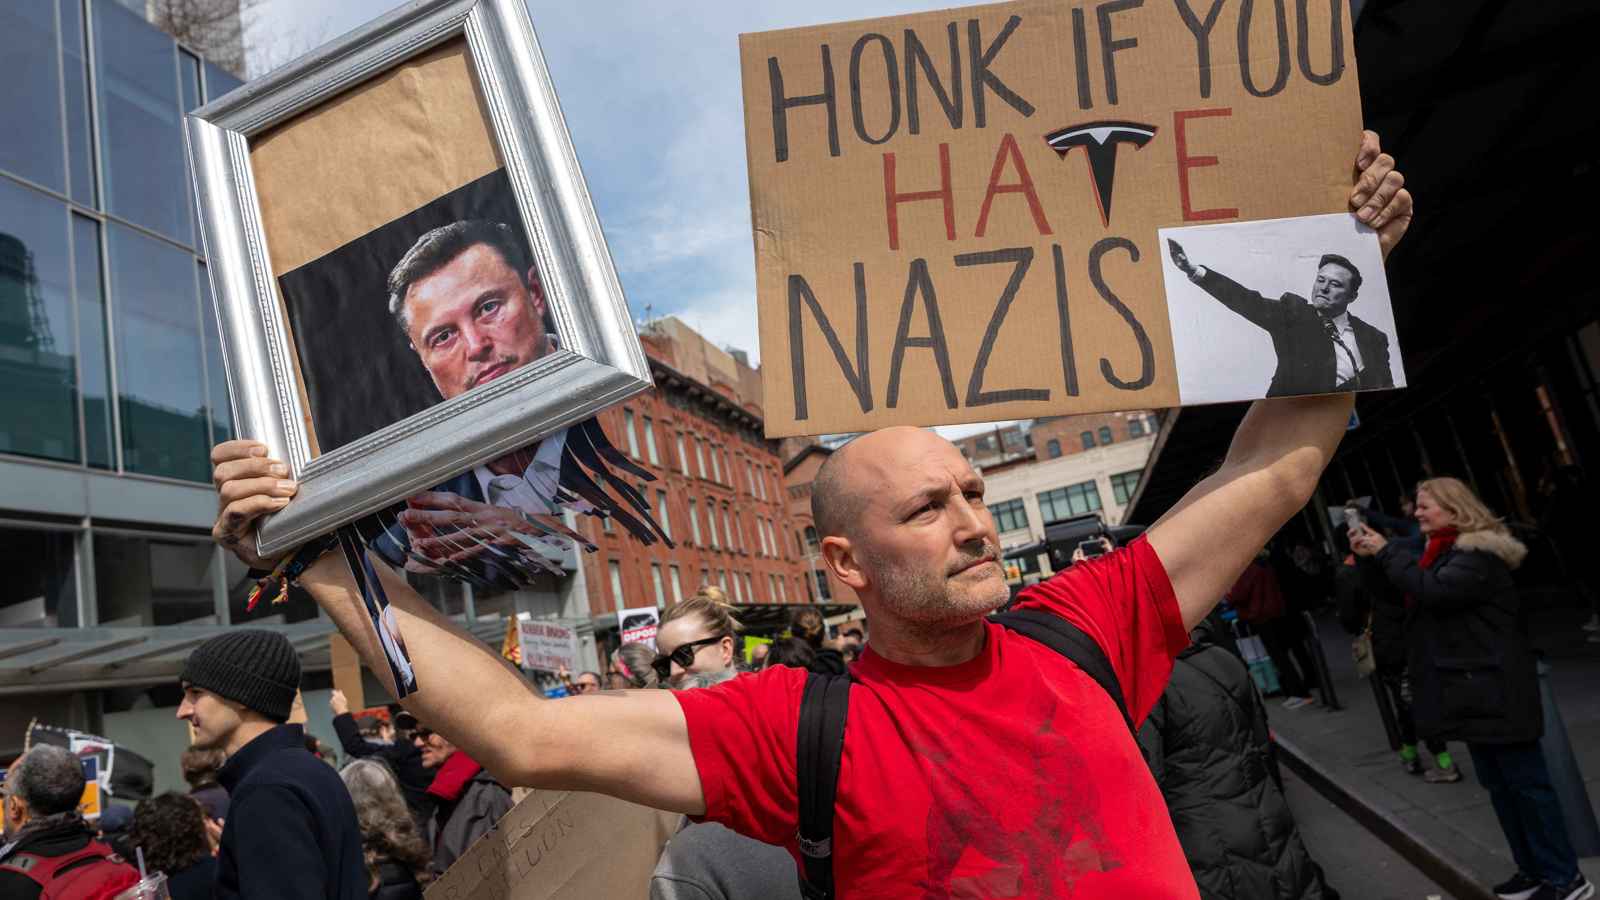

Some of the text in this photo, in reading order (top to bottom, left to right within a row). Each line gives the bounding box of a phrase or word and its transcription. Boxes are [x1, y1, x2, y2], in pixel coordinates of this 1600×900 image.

[768, 0, 1345, 162] HONK IF YOU
[788, 237, 1156, 420] NAZIS
